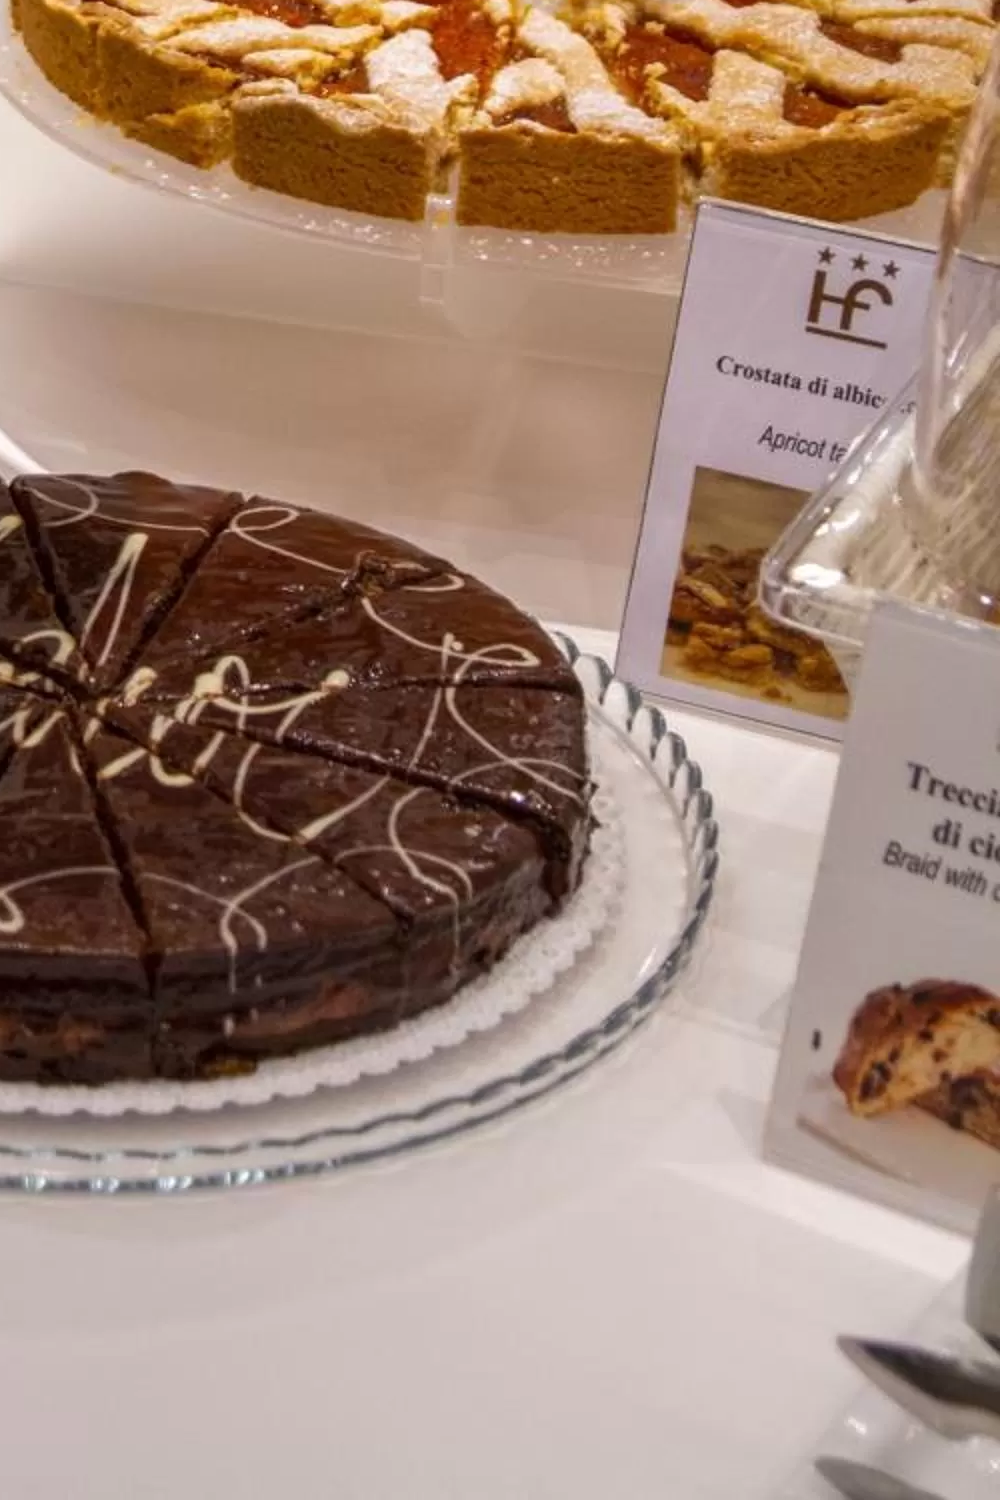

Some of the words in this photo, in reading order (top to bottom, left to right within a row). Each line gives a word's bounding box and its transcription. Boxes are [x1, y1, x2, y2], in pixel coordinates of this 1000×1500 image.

[715, 355, 802, 391] Crostata
[807, 376, 829, 398] di
[833, 383, 890, 410] albic
[757, 425, 827, 460] Apricot
[907, 760, 1000, 818] Trecci
[932, 818, 963, 849] di
[882, 840, 943, 883] Braid
[944, 865, 988, 897] with
